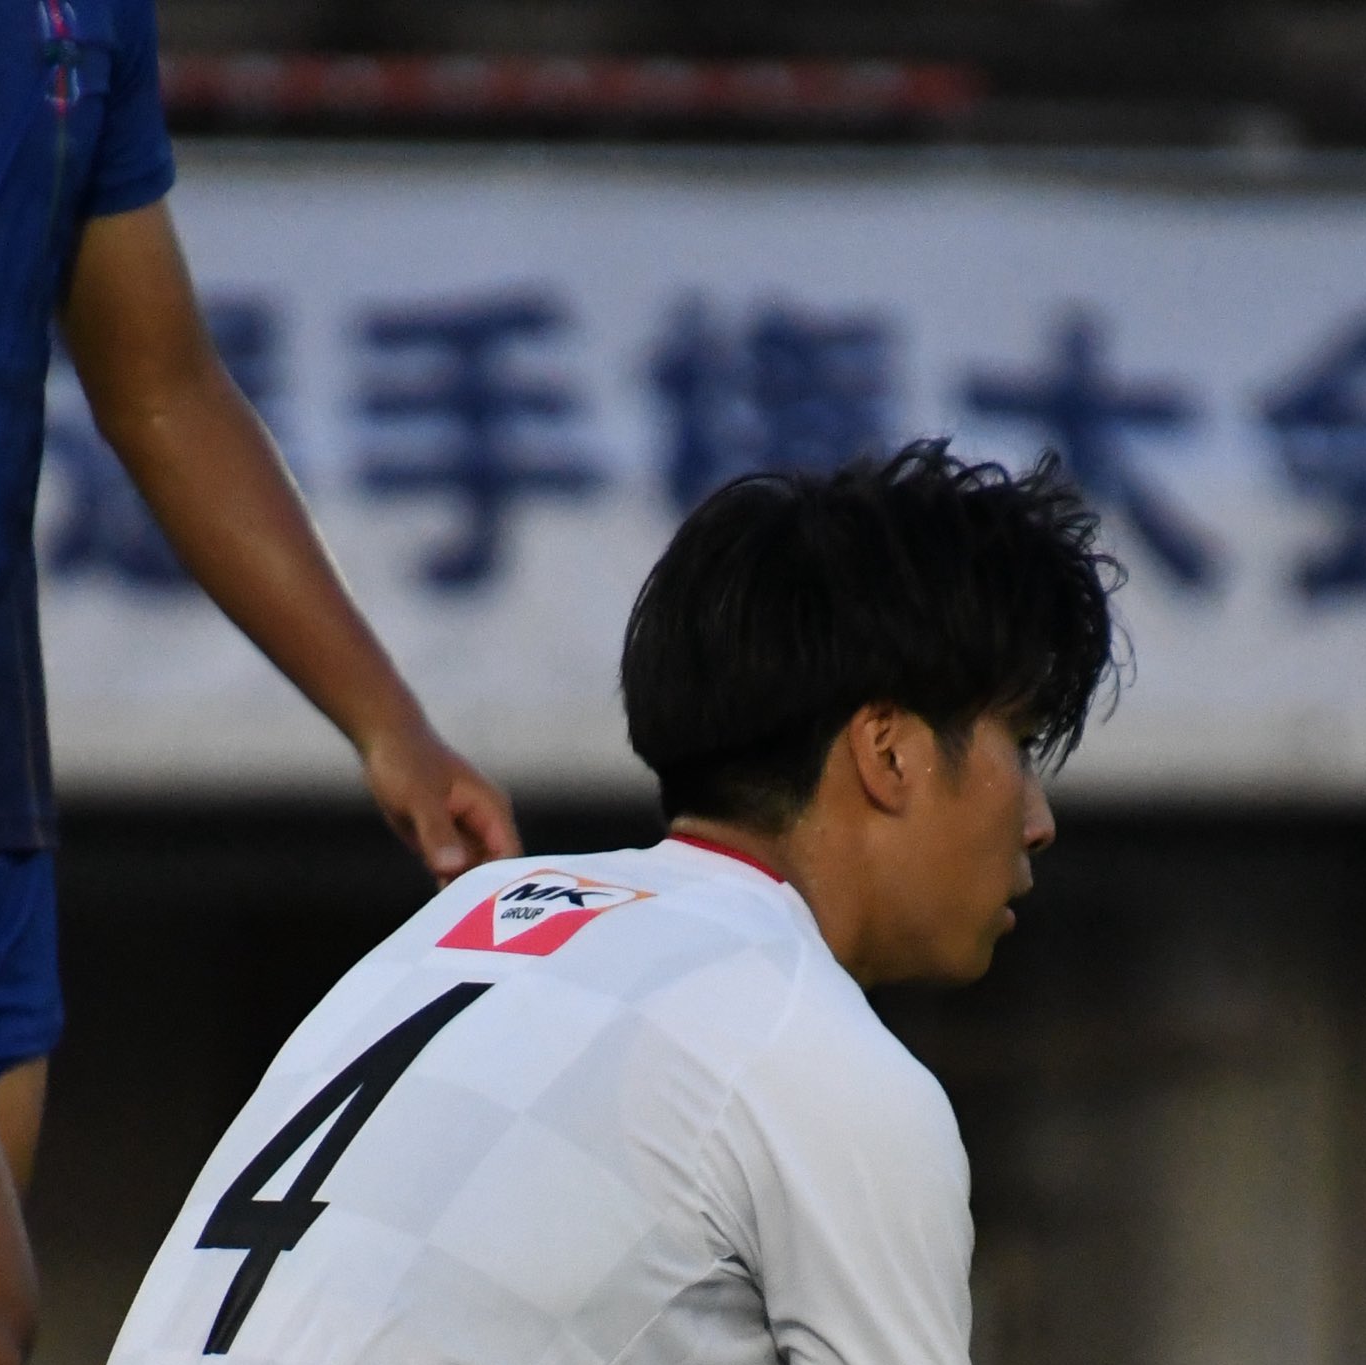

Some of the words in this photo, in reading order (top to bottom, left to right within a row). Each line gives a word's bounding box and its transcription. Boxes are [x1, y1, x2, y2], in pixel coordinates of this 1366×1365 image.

[497, 883, 614, 908] MK
[500, 906, 545, 921] GROUP
[194, 982, 496, 1355] 4
